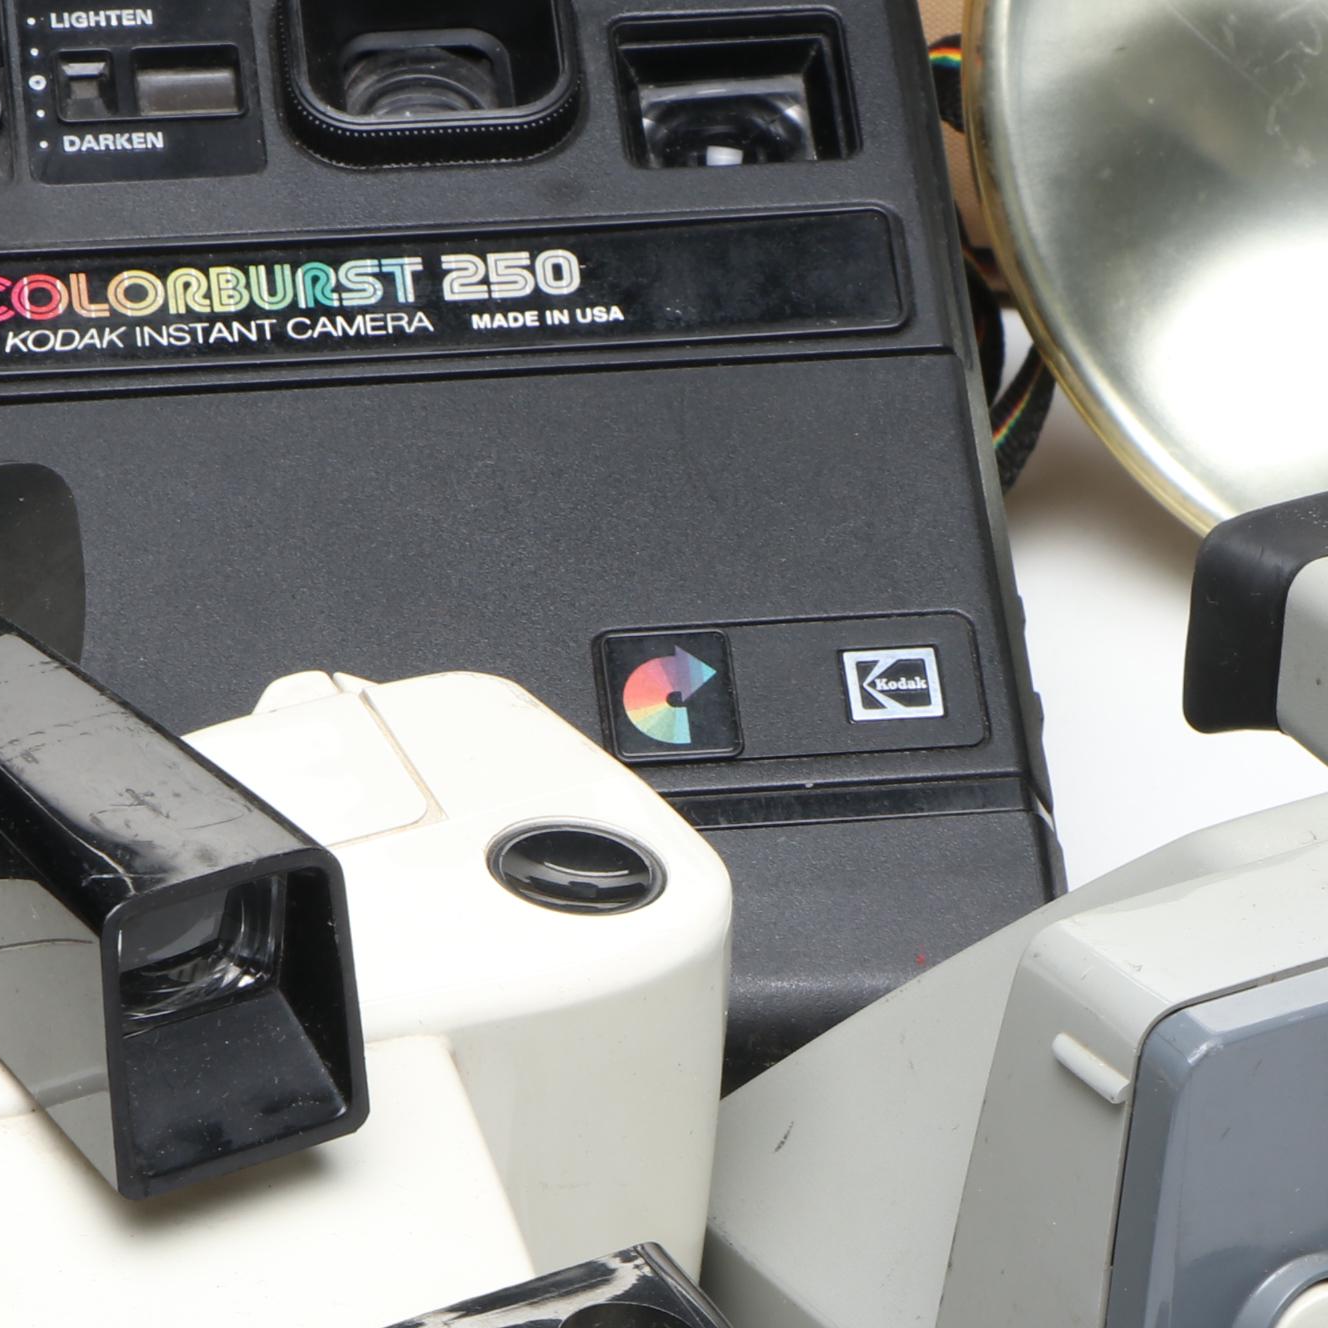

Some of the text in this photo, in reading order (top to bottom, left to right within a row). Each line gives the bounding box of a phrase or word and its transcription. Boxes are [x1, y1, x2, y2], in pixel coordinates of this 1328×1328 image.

[50, 9, 154, 29] LIGHTEN
[62, 131, 164, 152] DARKEN
[440, 249, 581, 301] 250
[471, 305, 624, 331] MADE IN USA
[4, 326, 128, 353] KODAK
[135, 318, 277, 347] INSTANT
[286, 311, 434, 340] CAMERA
[874, 676, 928, 690] Kodak
